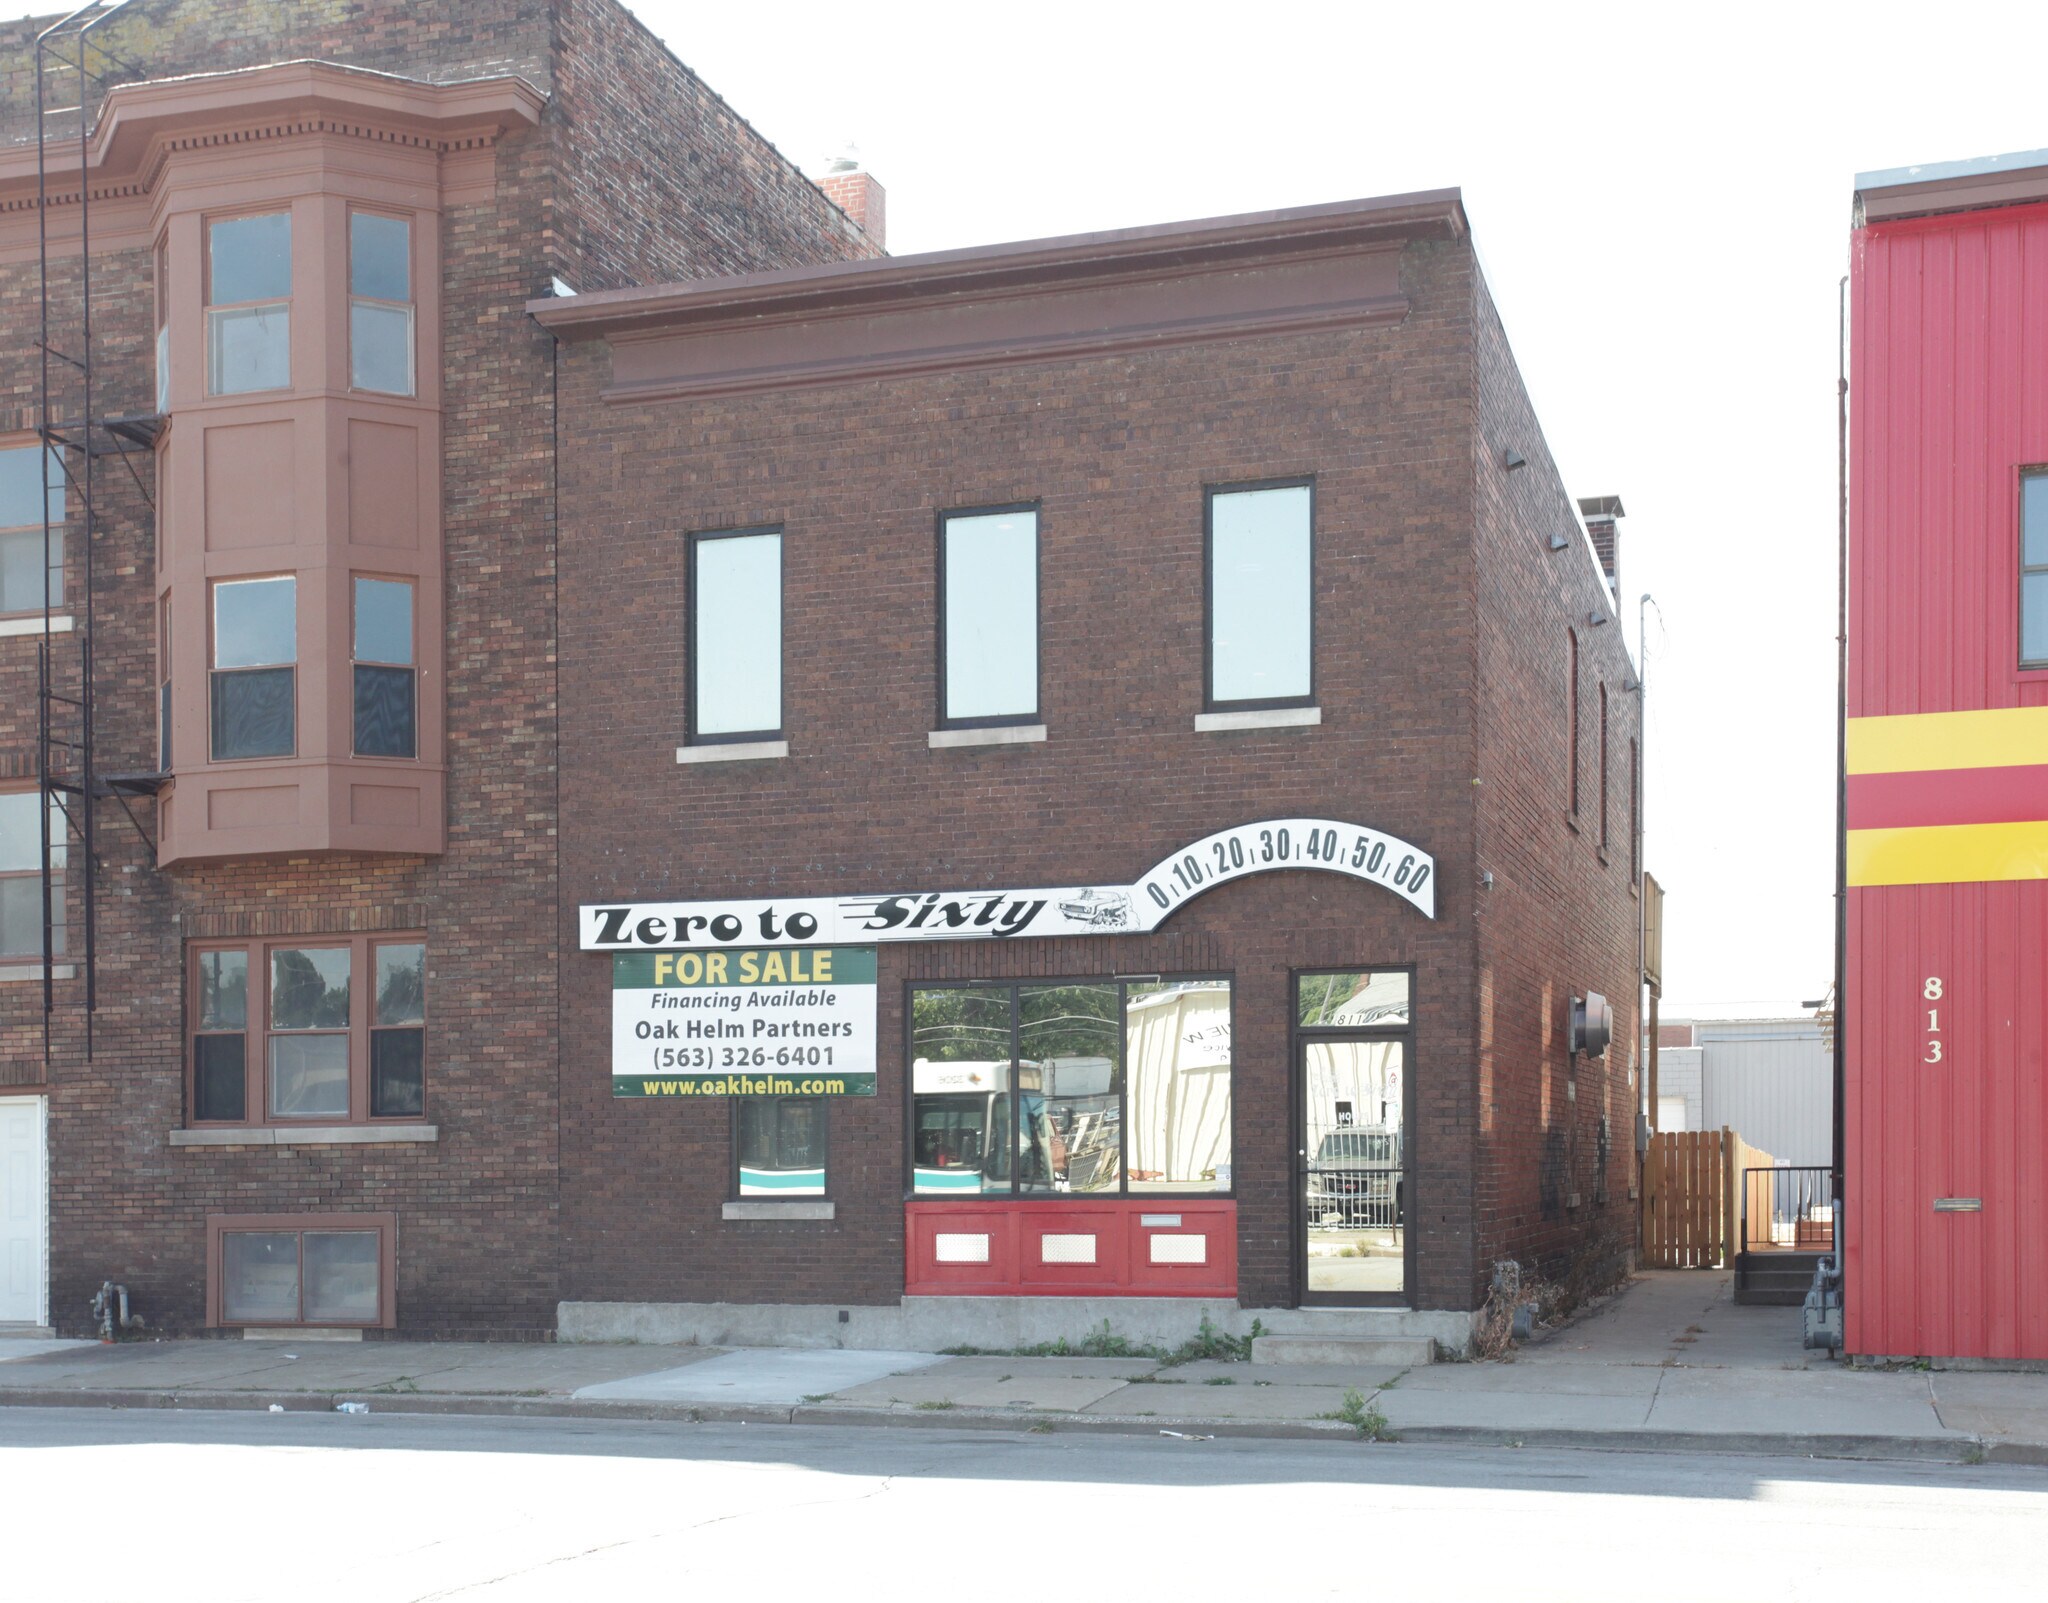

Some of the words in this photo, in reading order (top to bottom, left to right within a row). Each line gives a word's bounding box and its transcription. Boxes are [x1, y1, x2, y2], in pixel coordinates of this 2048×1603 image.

[1146, 882, 1170, 909] 0
[1172, 854, 1204, 891] 10
[1212, 836, 1244, 874] 20
[1260, 828, 1290, 862] 30
[1306, 828, 1337, 862] 40
[1351, 835, 1386, 874] 50
[1393, 854, 1431, 894] 60
[594, 908, 742, 945] Zero
[758, 905, 818, 940] to
[861, 893, 1049, 937] Sixty
[655, 953, 728, 985] FOR
[739, 950, 832, 984] SALE
[651, 991, 742, 1012] Financing
[747, 989, 836, 1007] Available
[635, 1019, 679, 1039] Oak
[687, 1018, 744, 1038] Helm
[753, 1018, 853, 1038] Partners
[1337, 1014, 1362, 1025] 811
[653, 1046, 714, 1070] (563)
[721, 1046, 833, 1067] 326-6401
[643, 1075, 845, 1095] www.oakhelm.com
